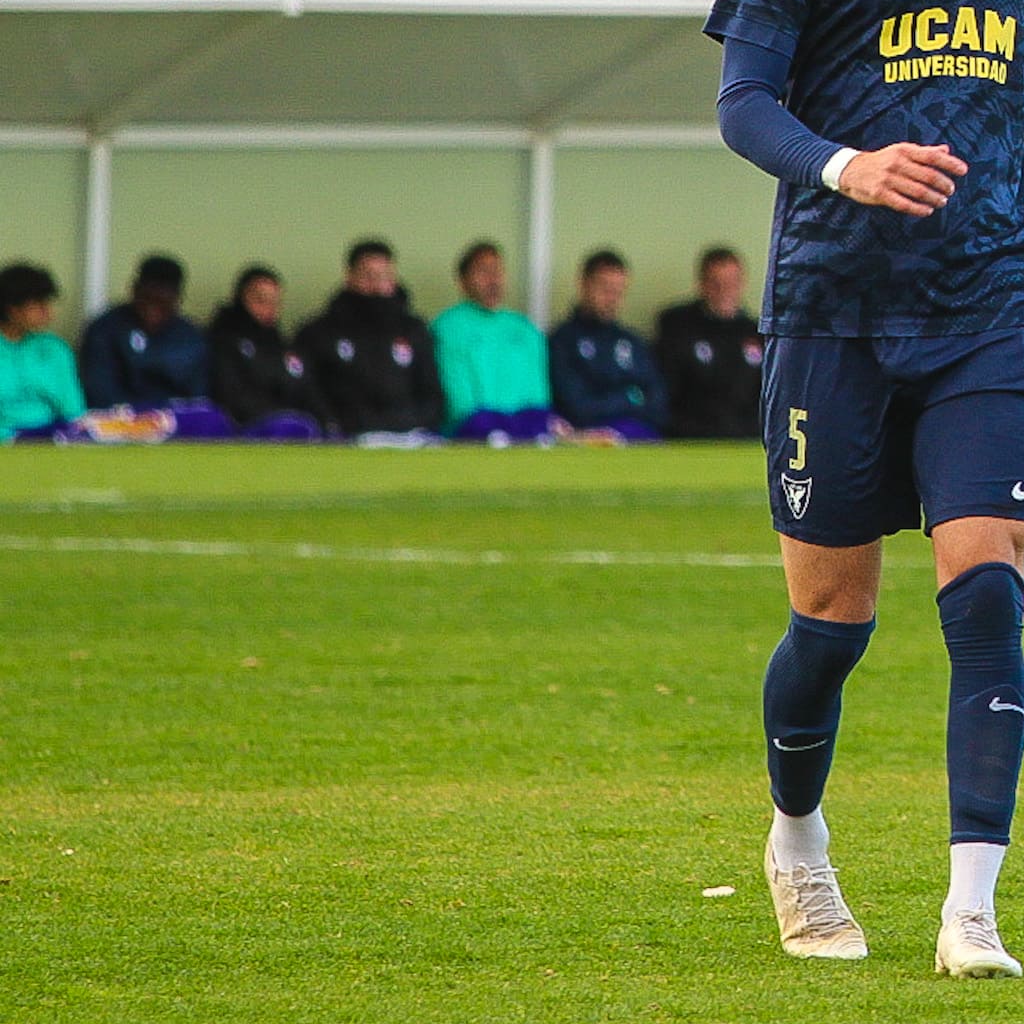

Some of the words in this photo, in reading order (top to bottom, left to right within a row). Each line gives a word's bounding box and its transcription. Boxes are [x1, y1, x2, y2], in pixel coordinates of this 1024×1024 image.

[879, 6, 1017, 62] UCAM
[884, 54, 1008, 84] UNIVERSIDAD
[789, 407, 808, 470] 5
